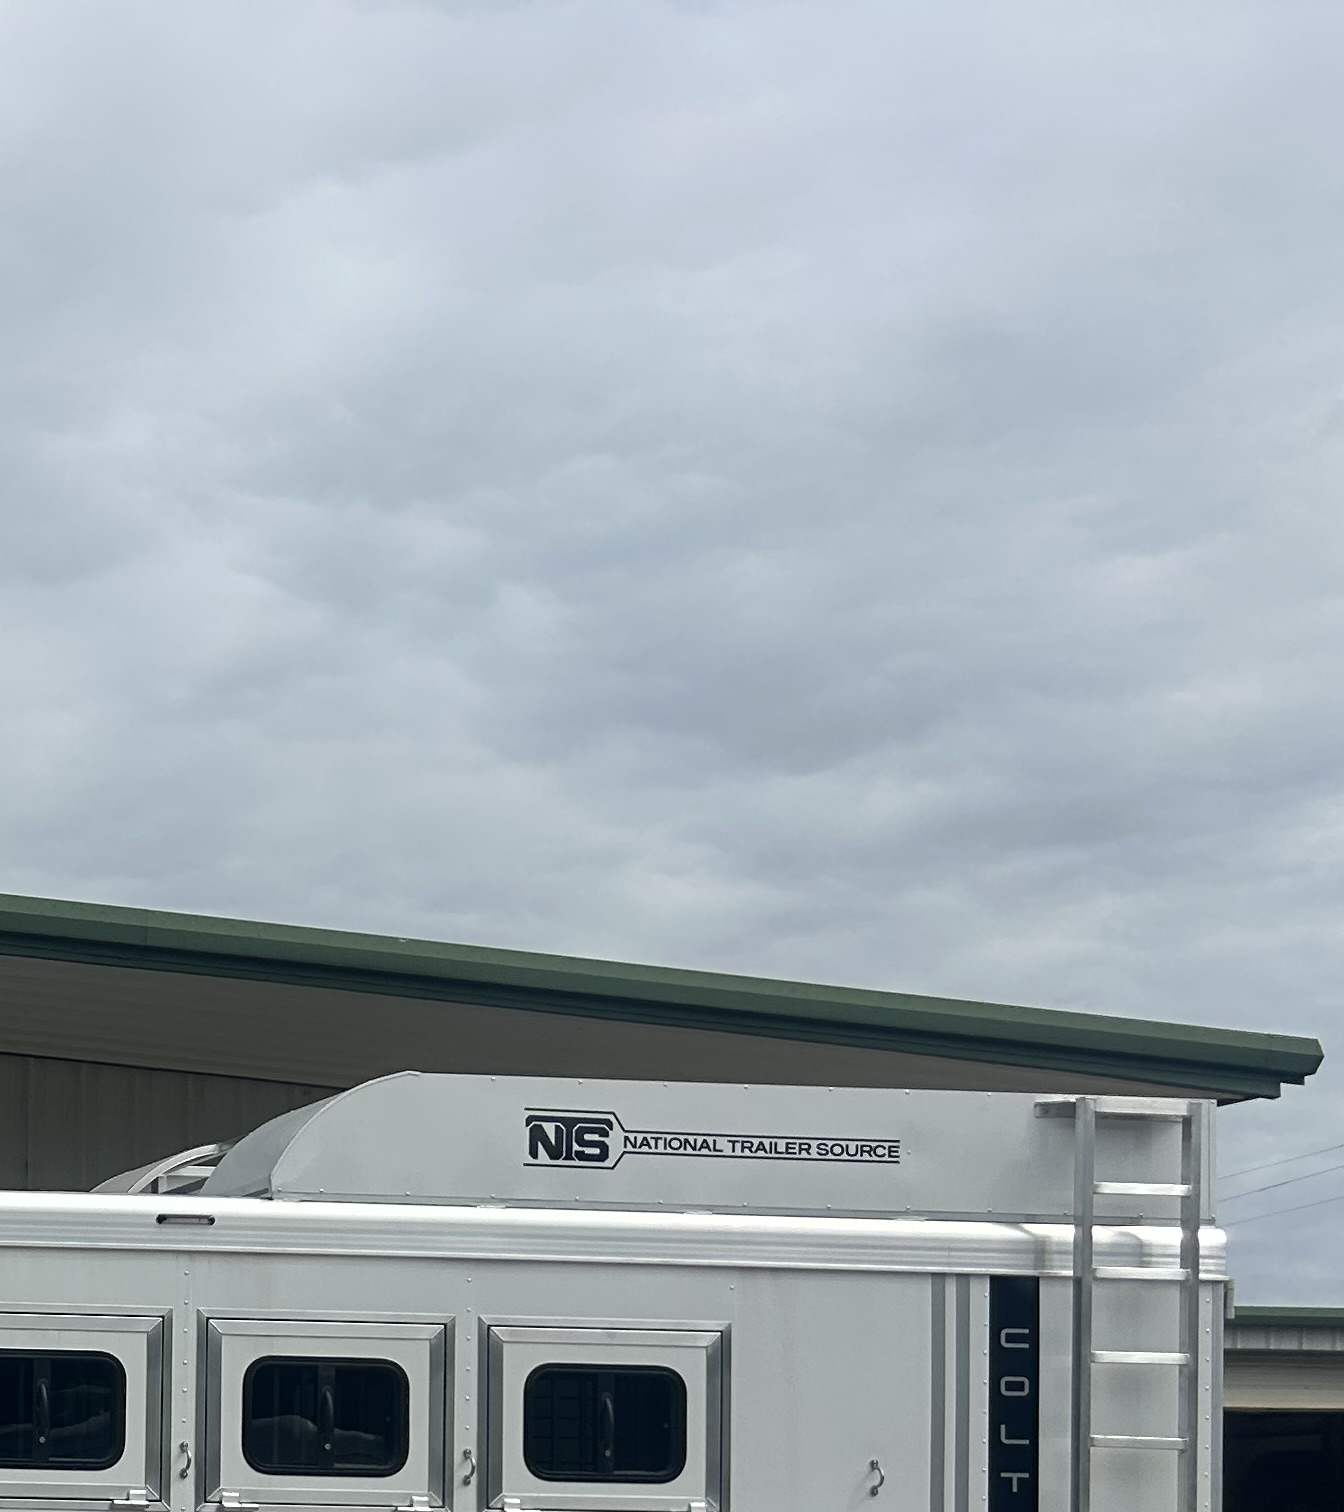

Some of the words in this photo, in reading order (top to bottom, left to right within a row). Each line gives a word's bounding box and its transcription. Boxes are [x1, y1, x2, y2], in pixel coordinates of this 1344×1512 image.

[525, 1115, 614, 1162] NTS
[623, 1135, 724, 1153] NATIONAL
[727, 1139, 812, 1156] TRAILER
[816, 1142, 901, 1159] SOURCE
[1000, 1328, 1030, 1492] COLT
